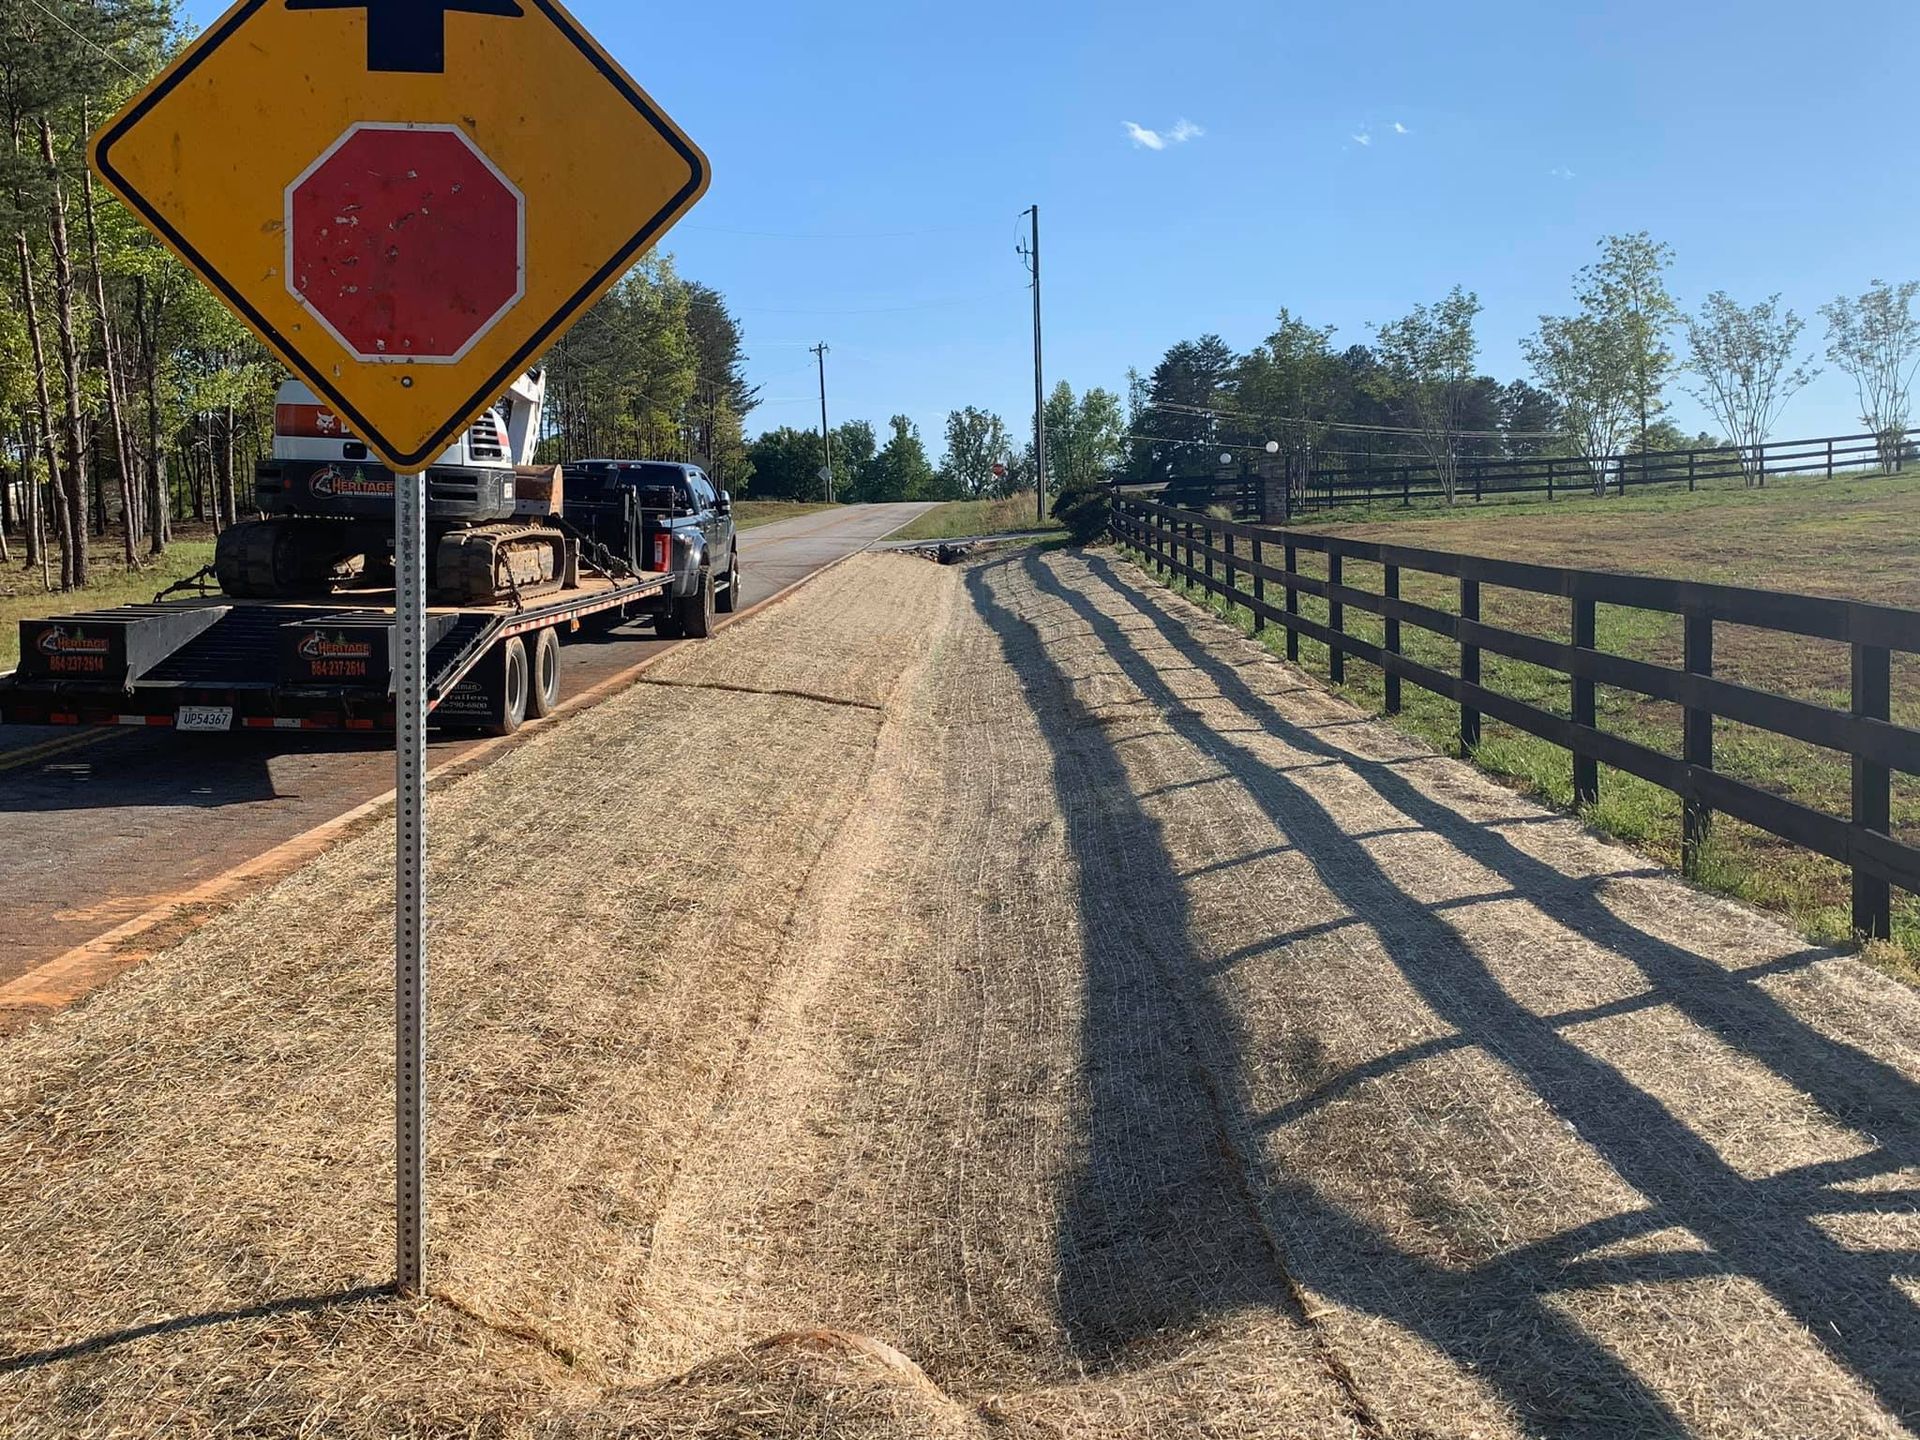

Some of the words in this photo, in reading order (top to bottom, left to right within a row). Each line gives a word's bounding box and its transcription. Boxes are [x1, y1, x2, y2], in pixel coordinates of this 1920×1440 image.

[332, 477, 394, 493] HERITAGE
[57, 637, 107, 649] HERITAGE
[318, 641, 369, 654] HERITAGE
[183, 713, 228, 725] UP54367
